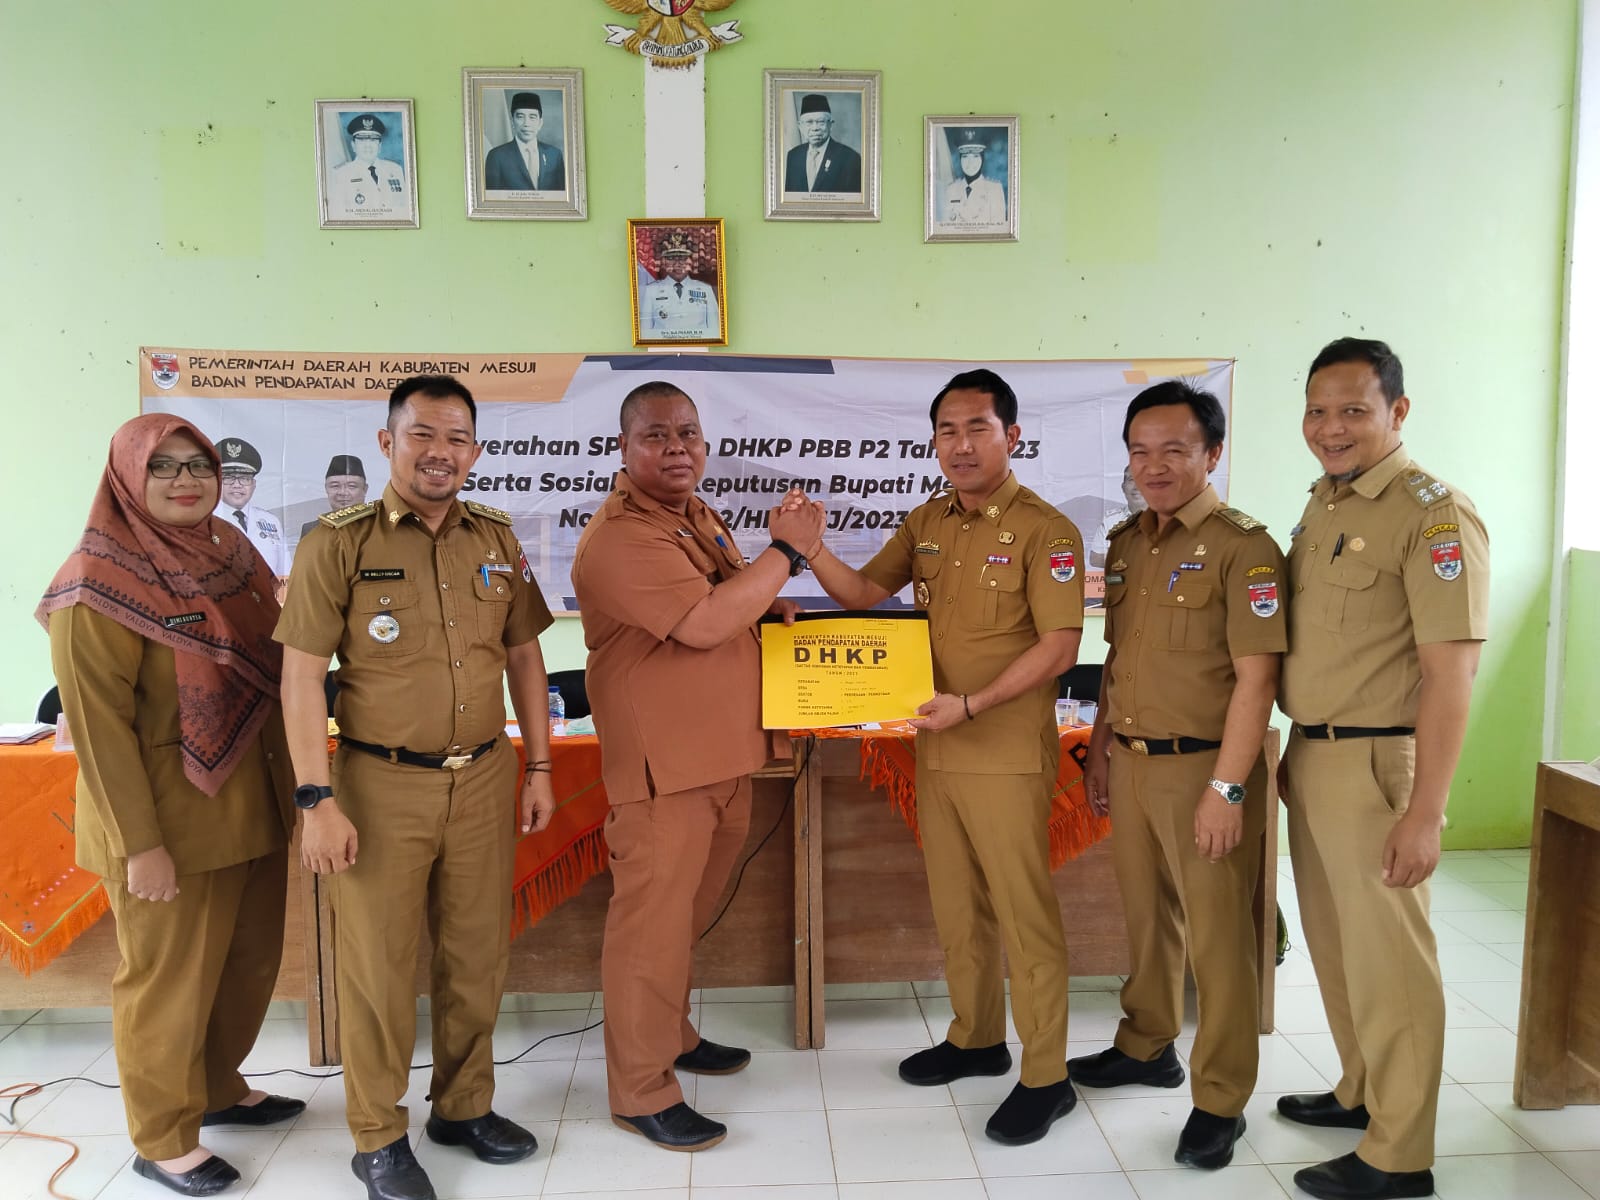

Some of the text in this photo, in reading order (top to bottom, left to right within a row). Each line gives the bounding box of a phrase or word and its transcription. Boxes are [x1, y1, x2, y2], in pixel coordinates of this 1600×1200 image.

[189, 356, 536, 374] PEMERINTAH DAERAH KABUPATEN MESUJI
[191, 375, 245, 388] BADAN
[255, 375, 355, 390] PENDAPATAN
[719, 437, 793, 457] DHKP
[799, 439, 852, 458] PBB
[858, 439, 890, 459] P2
[897, 439, 939, 459] Tah
[1010, 440, 1040, 459] 23
[462, 471, 532, 492] Serta
[539, 470, 618, 492] Sosial
[696, 474, 822, 497] eputusan
[829, 473, 915, 499] Bupati
[124, 612, 155, 633] VALDYA
[161, 631, 193, 648] VALDYA
[793, 647, 888, 665] DHKP
